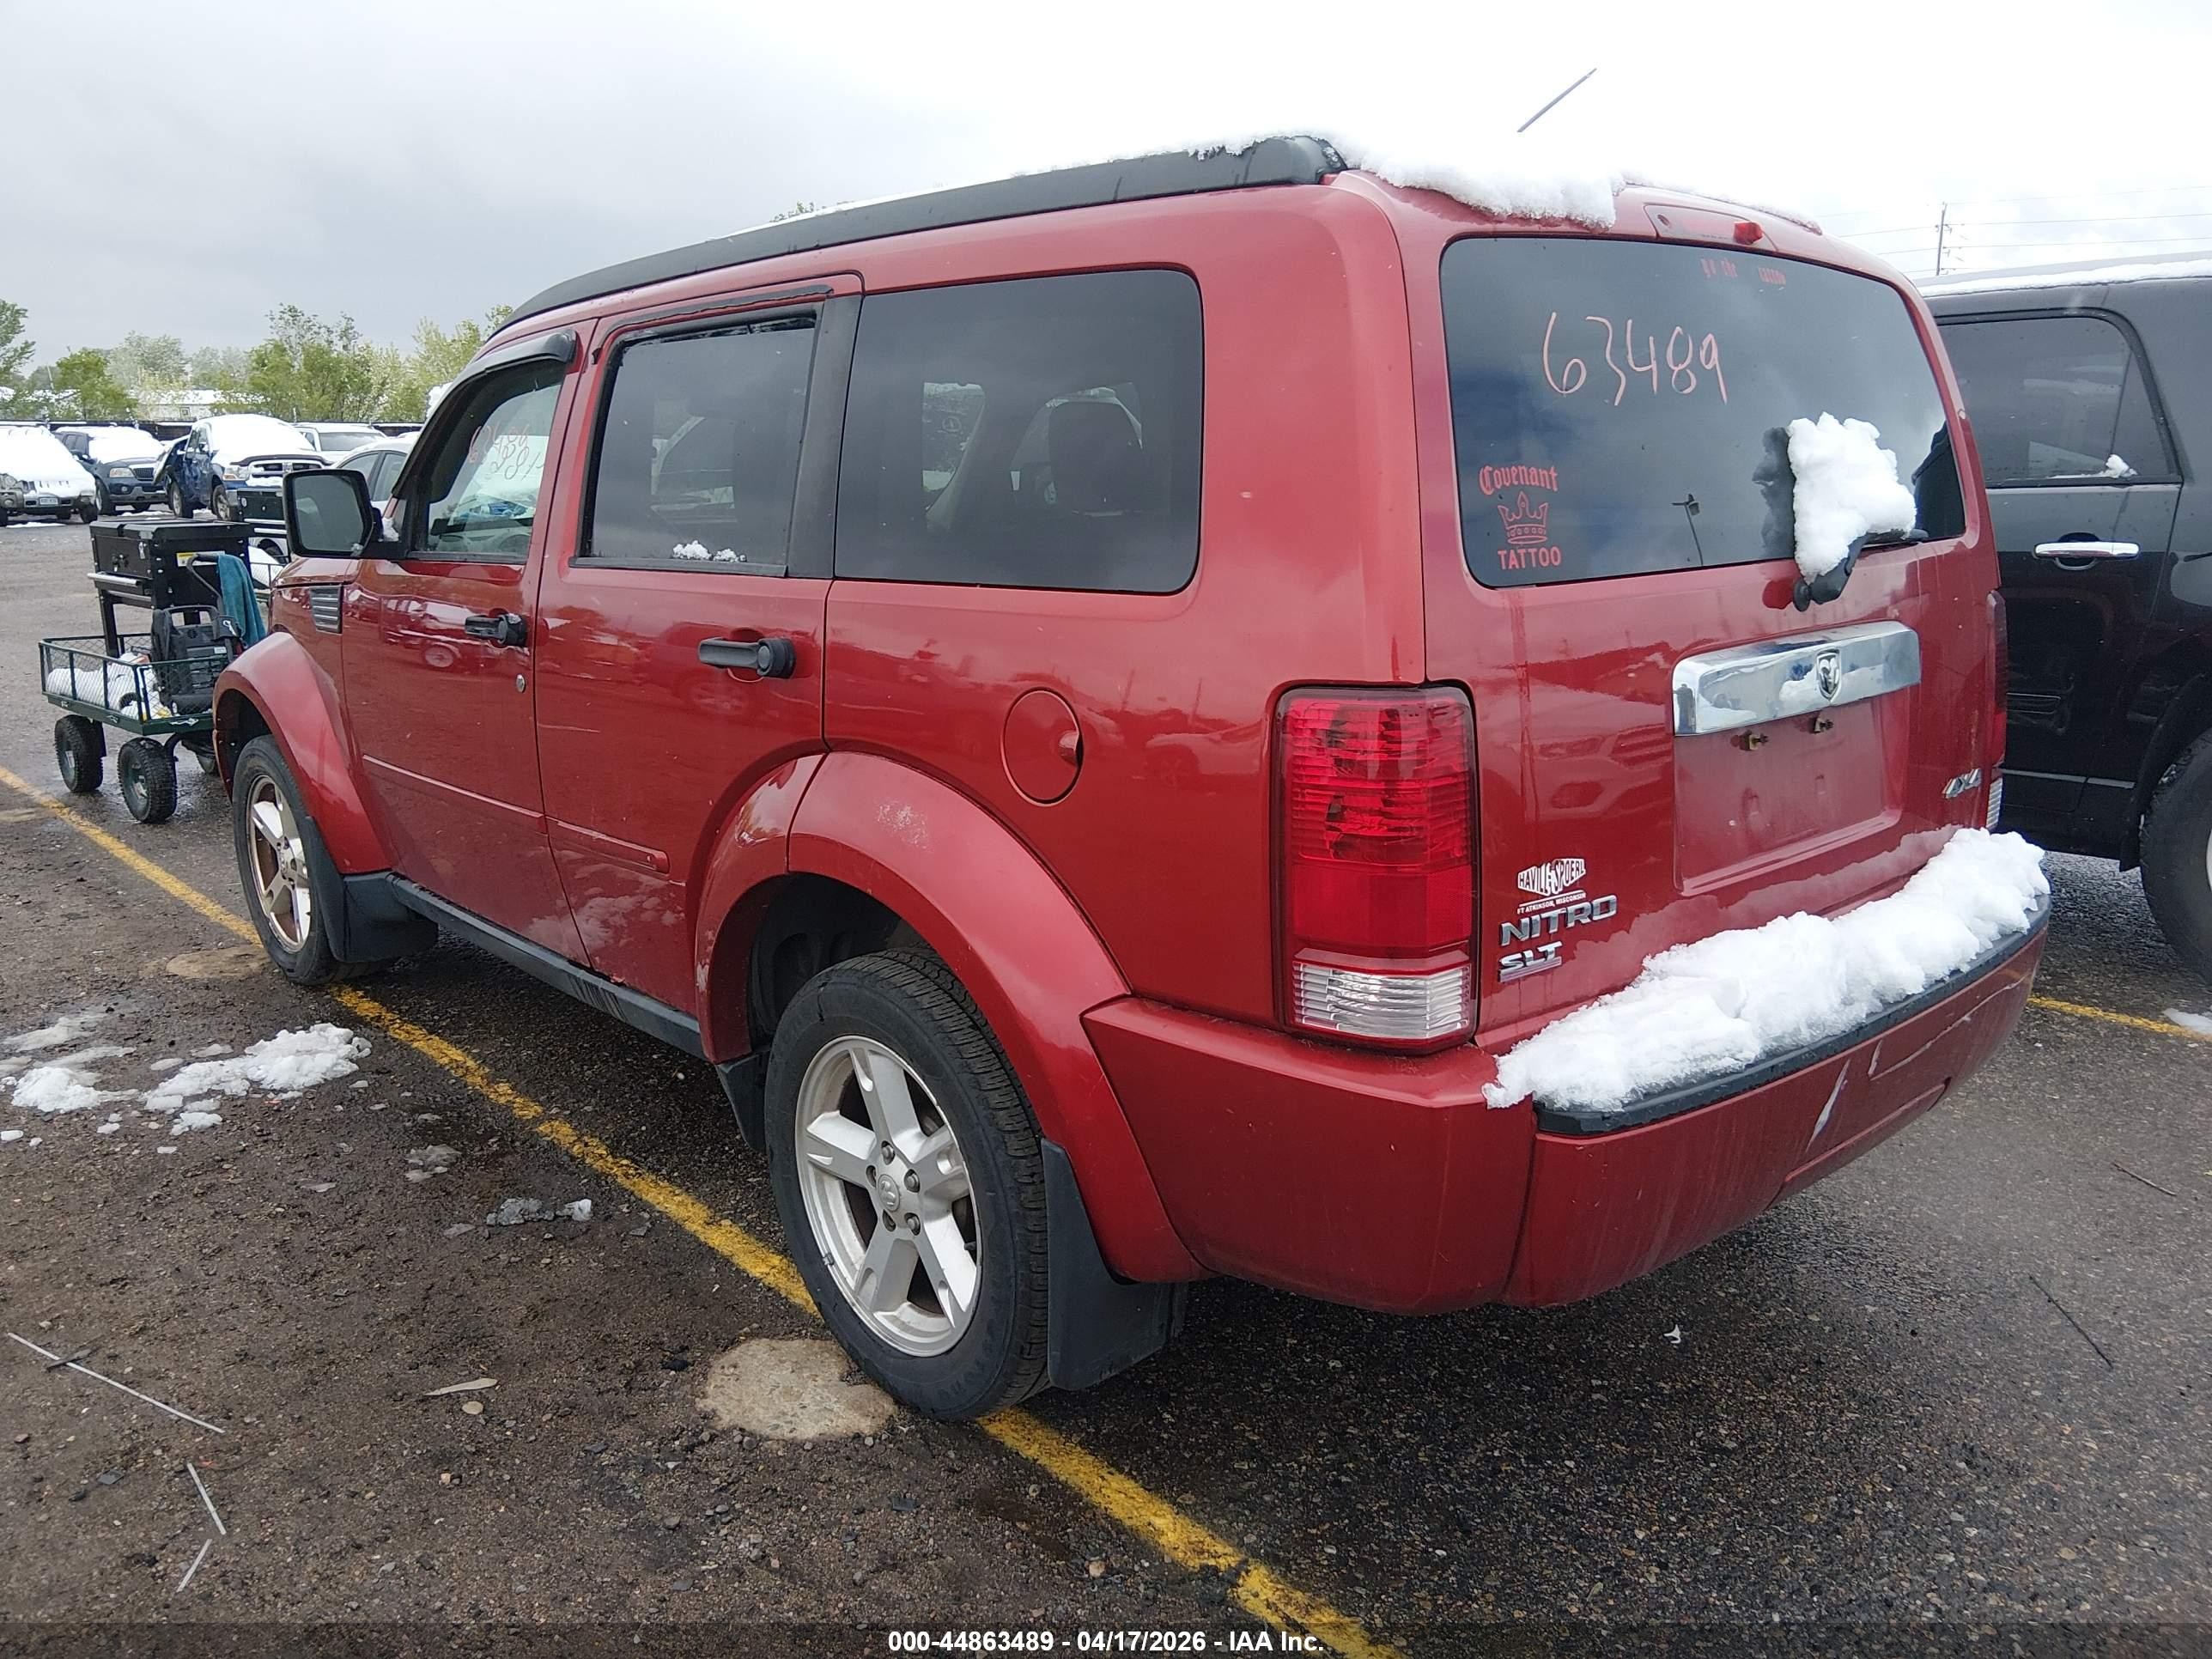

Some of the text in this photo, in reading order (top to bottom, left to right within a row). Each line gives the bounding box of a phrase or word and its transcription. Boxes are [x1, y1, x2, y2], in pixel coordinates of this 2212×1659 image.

[1543, 312, 1727, 405] 63489
[1479, 465, 1559, 495] Covenant
[1497, 546, 1561, 570] TATTOO
[1500, 894, 1618, 947] NITRO
[1499, 941, 1563, 970] SLT
